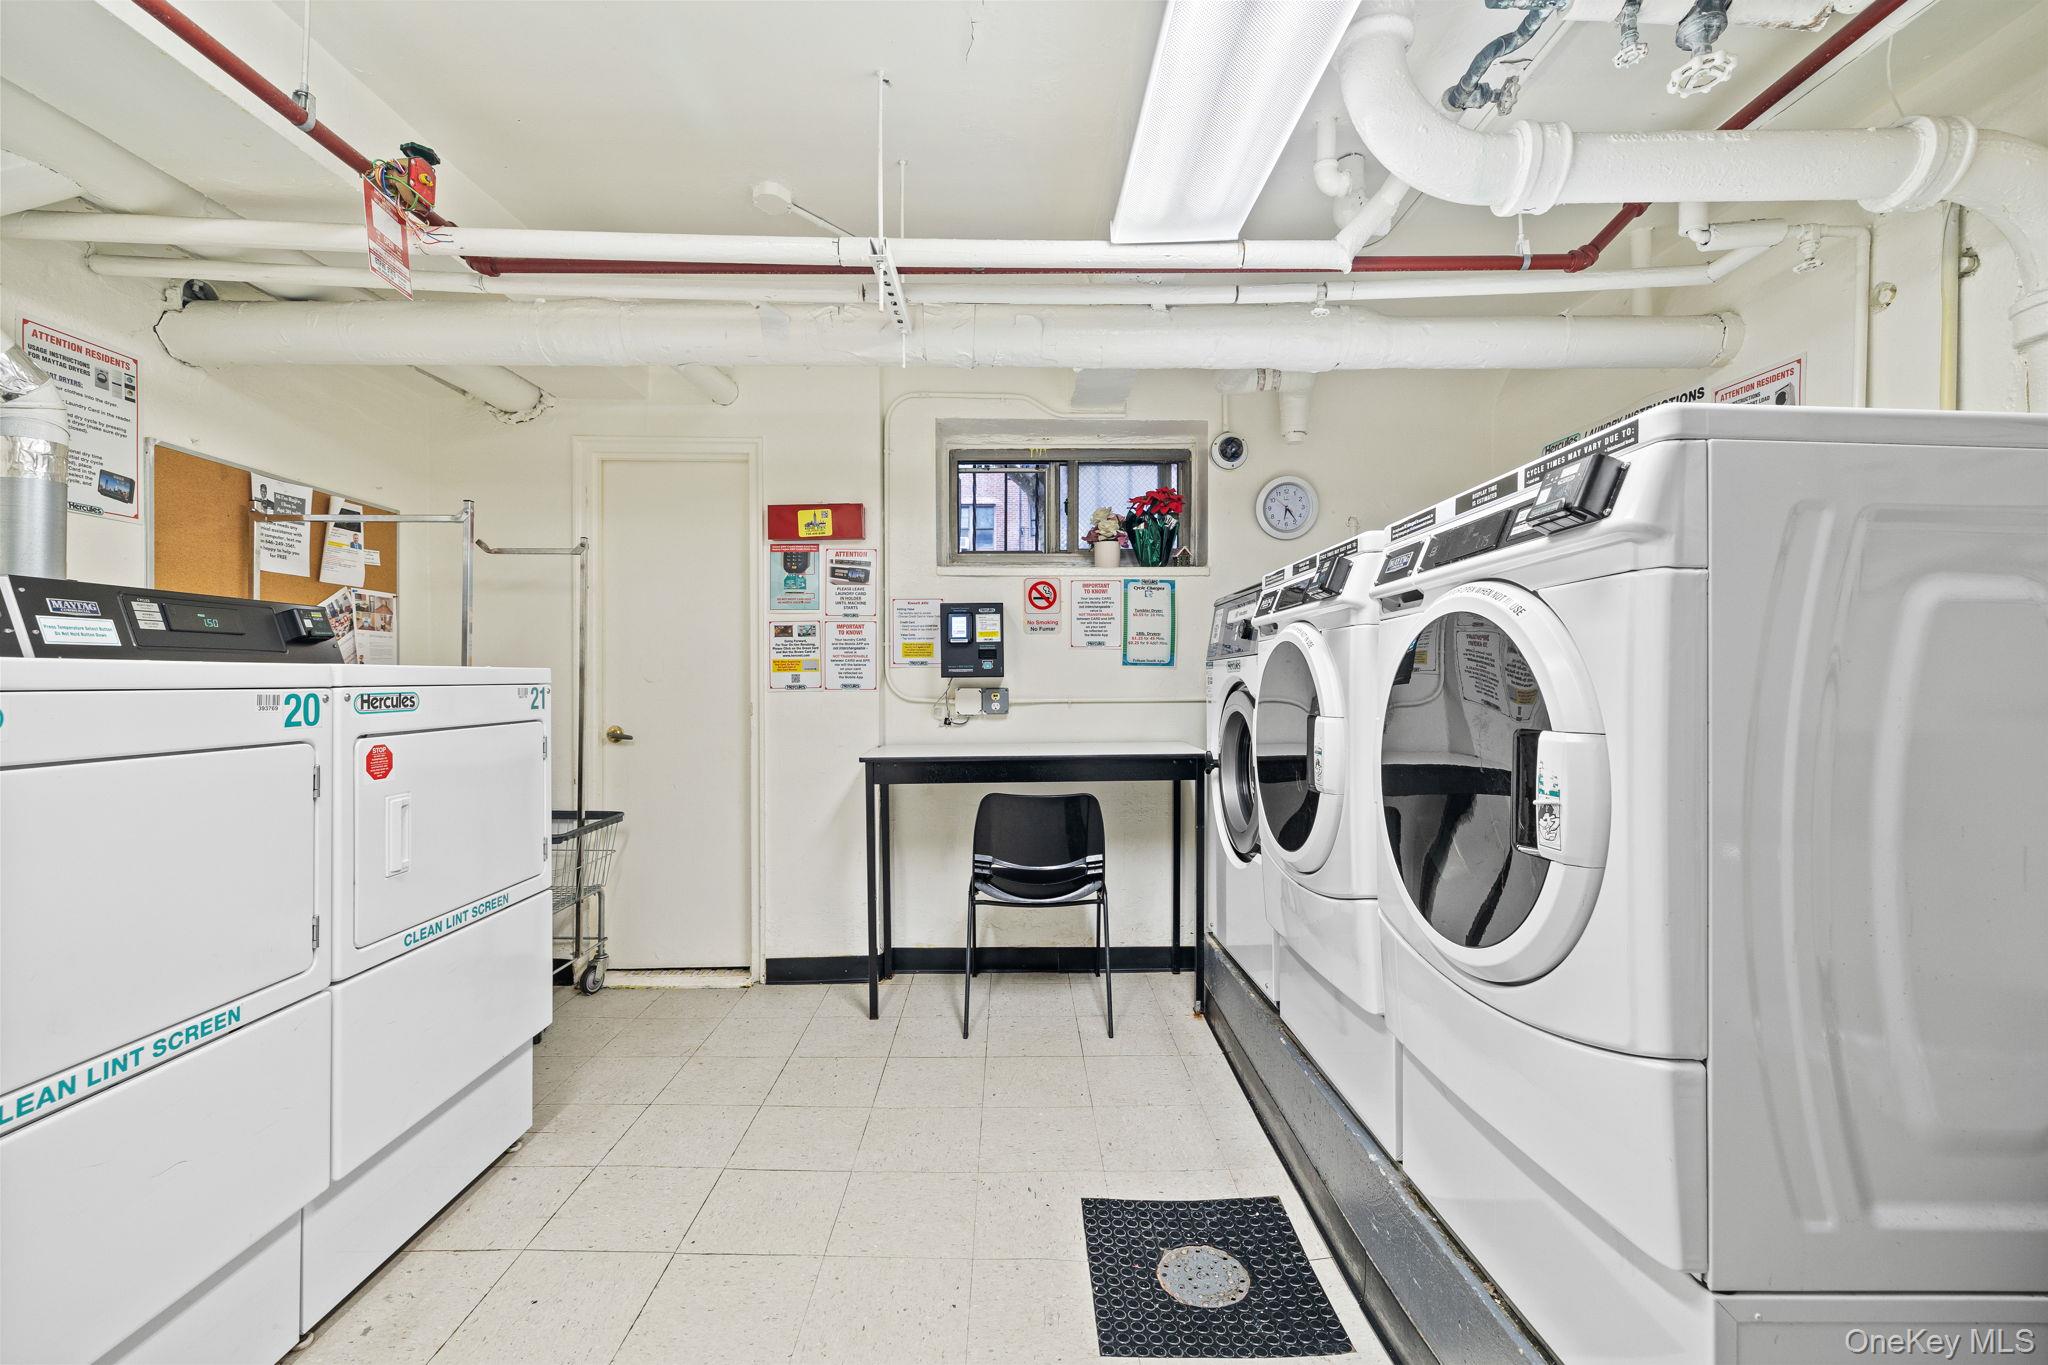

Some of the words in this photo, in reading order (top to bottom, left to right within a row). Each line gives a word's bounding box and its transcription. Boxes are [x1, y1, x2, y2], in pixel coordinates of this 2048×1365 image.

[28, 344, 48, 354] USAGE
[49, 350, 90, 369] INSTRUCTIONS
[32, 329, 82, 354] ATTENTION
[85, 348, 130, 370] RESIDENTS
[28, 352, 40, 360] FOR
[42, 356, 67, 369] MAYTAG
[68, 365, 90, 377] DRYERS
[58, 374, 83, 388] DRYERS:
[1720, 384, 1754, 402] ATTENTION
[1756, 368, 1794, 388] RESIDENTS
[64, 386, 83, 398] clothes
[84, 392, 94, 400] into
[66, 400, 88, 413] Laundry
[88, 406, 100, 414] Card
[70, 420, 86, 429] dryer
[87, 424, 102, 432] (make
[114, 430, 128, 438] dryer
[74, 414, 83, 422] dry
[84, 416, 98, 425] cycle
[106, 423, 126, 434] pressing
[1545, 436, 1578, 454] Hercules
[1624, 386, 1705, 420] INSTTIONS
[80, 456, 89, 465] dry
[82, 451, 91, 459] dry
[1526, 465, 1544, 478] CYCLE
[1546, 456, 1565, 470] TIMES
[1567, 449, 1581, 460] MAY
[1584, 440, 1602, 454] VARY
[1604, 433, 1619, 445] DUE
[1622, 427, 1635, 437] TO:
[1472, 488, 1487, 500] DISPLAY
[1488, 484, 1498, 492] TIME
[1477, 492, 1498, 505] ESTIMATED
[68, 502, 102, 514] Hercules
[51, 600, 97, 611] MAYTAG
[1476, 587, 1492, 596] WHEN
[1492, 592, 1506, 601] NOT
[1509, 603, 1526, 616] USE
[360, 693, 415, 710] Hercules
[530, 687, 546, 710] 21
[284, 693, 320, 728] 20
[404, 921, 442, 947] CLEAN
[446, 910, 469, 929] LINT
[472, 893, 509, 918] SCREEN
[0, 1075, 76, 1126] LEAN
[87, 1046, 144, 1087] LINT
[152, 1006, 241, 1057] SCREEN
